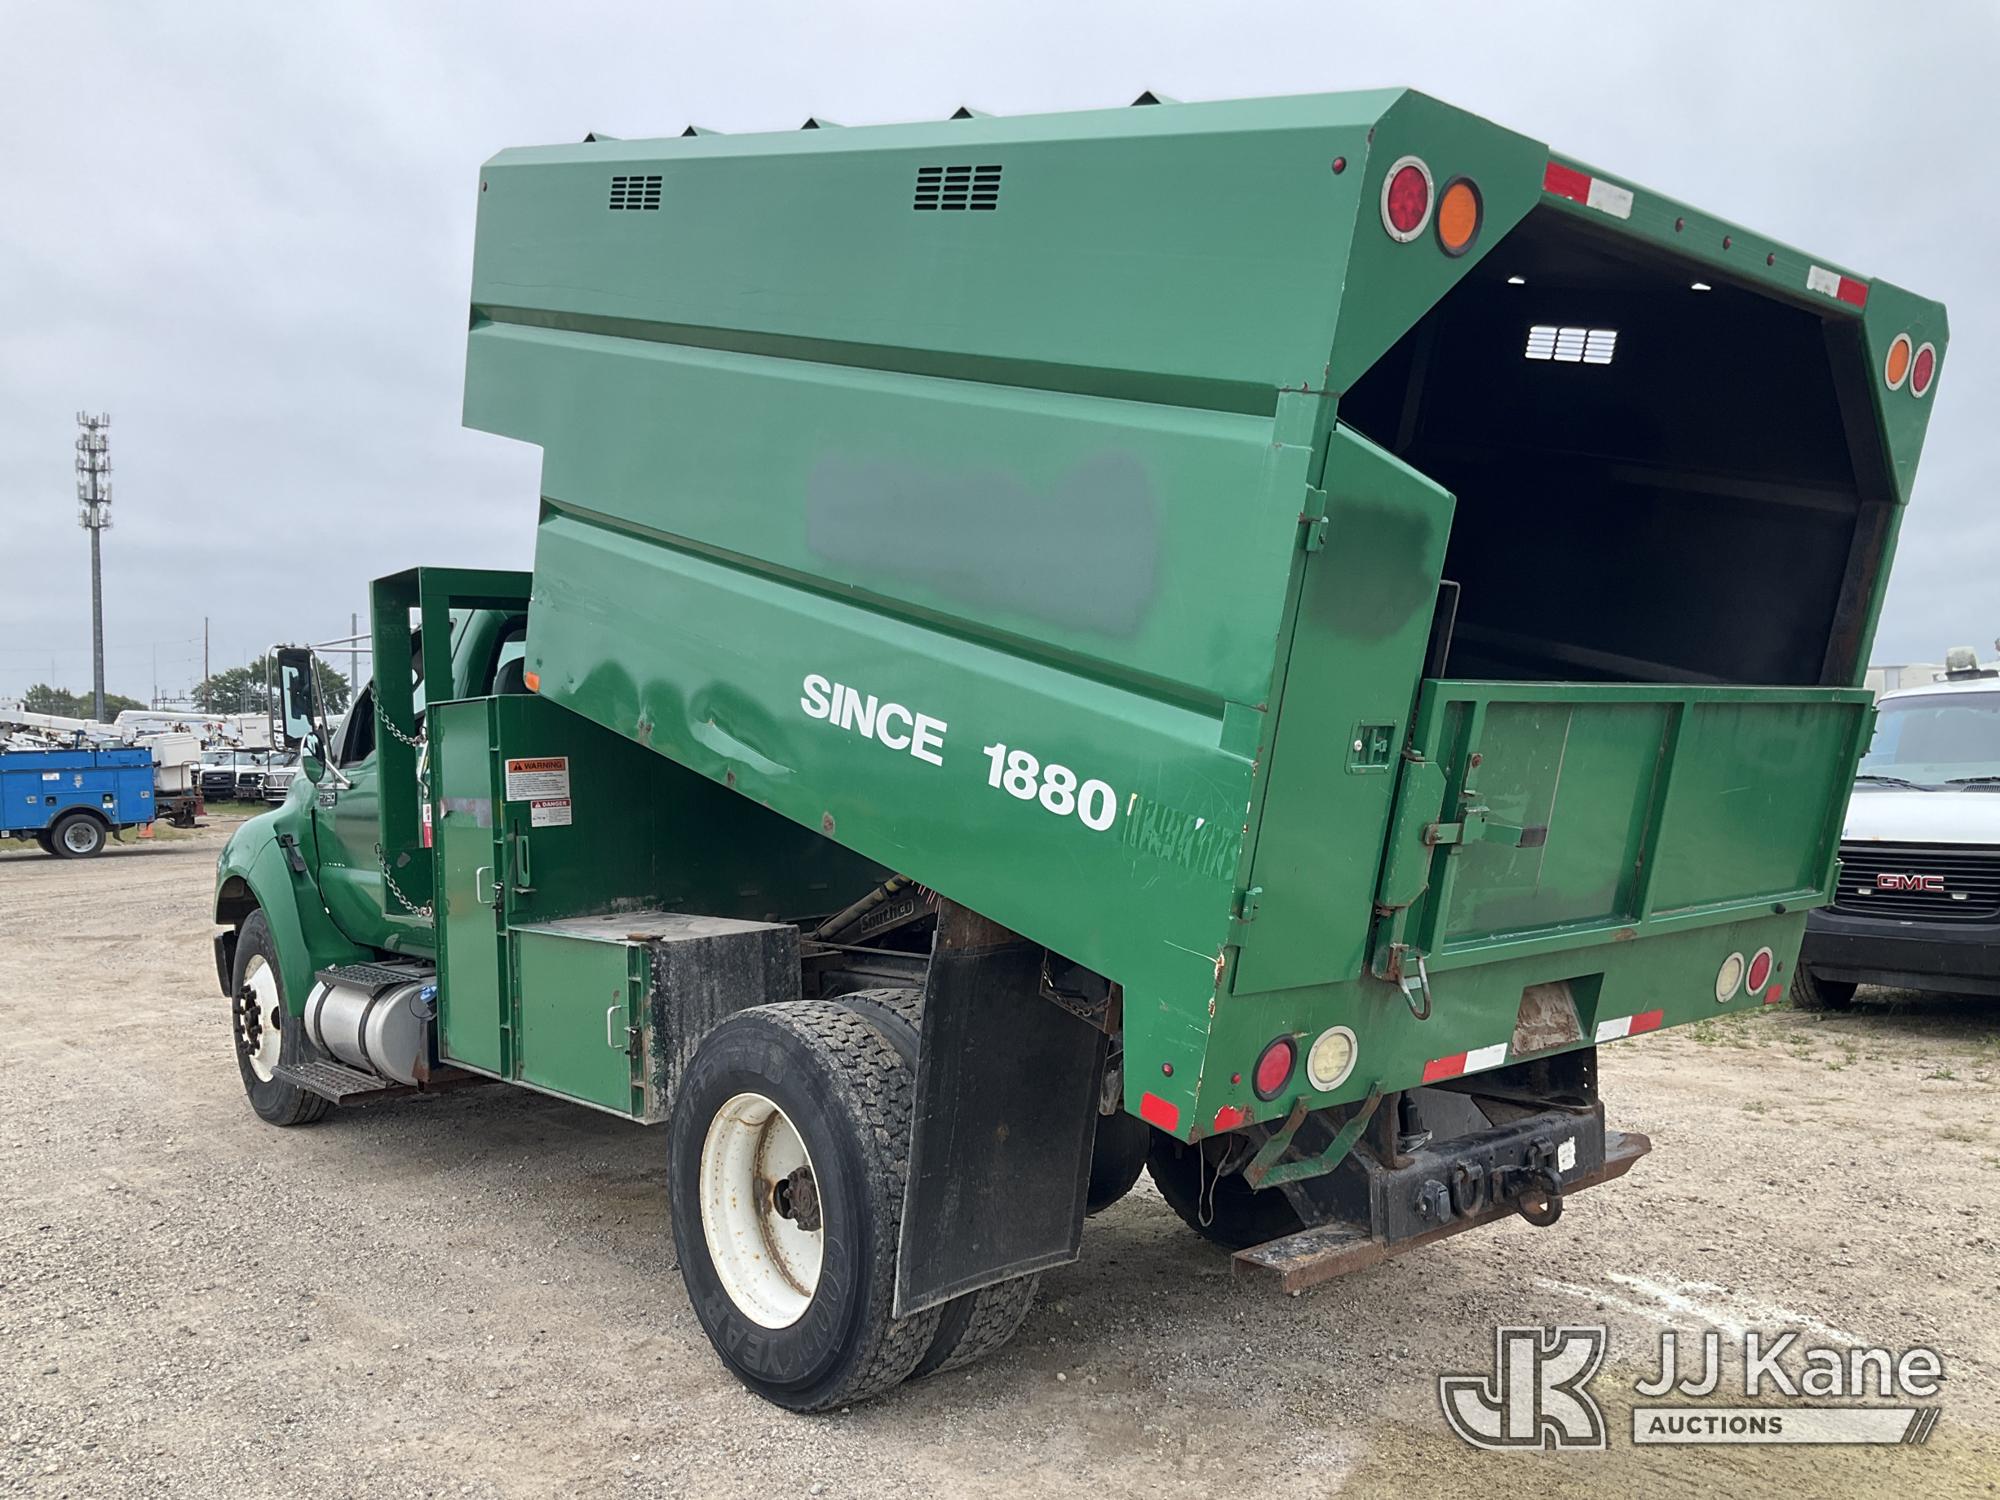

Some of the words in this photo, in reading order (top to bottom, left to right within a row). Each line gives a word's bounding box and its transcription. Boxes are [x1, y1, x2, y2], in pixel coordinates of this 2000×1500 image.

[801, 674, 947, 766] SINCE
[983, 743, 1117, 831] 1880
[524, 761, 562, 770] WARNING
[1877, 873, 1945, 891] GMC
